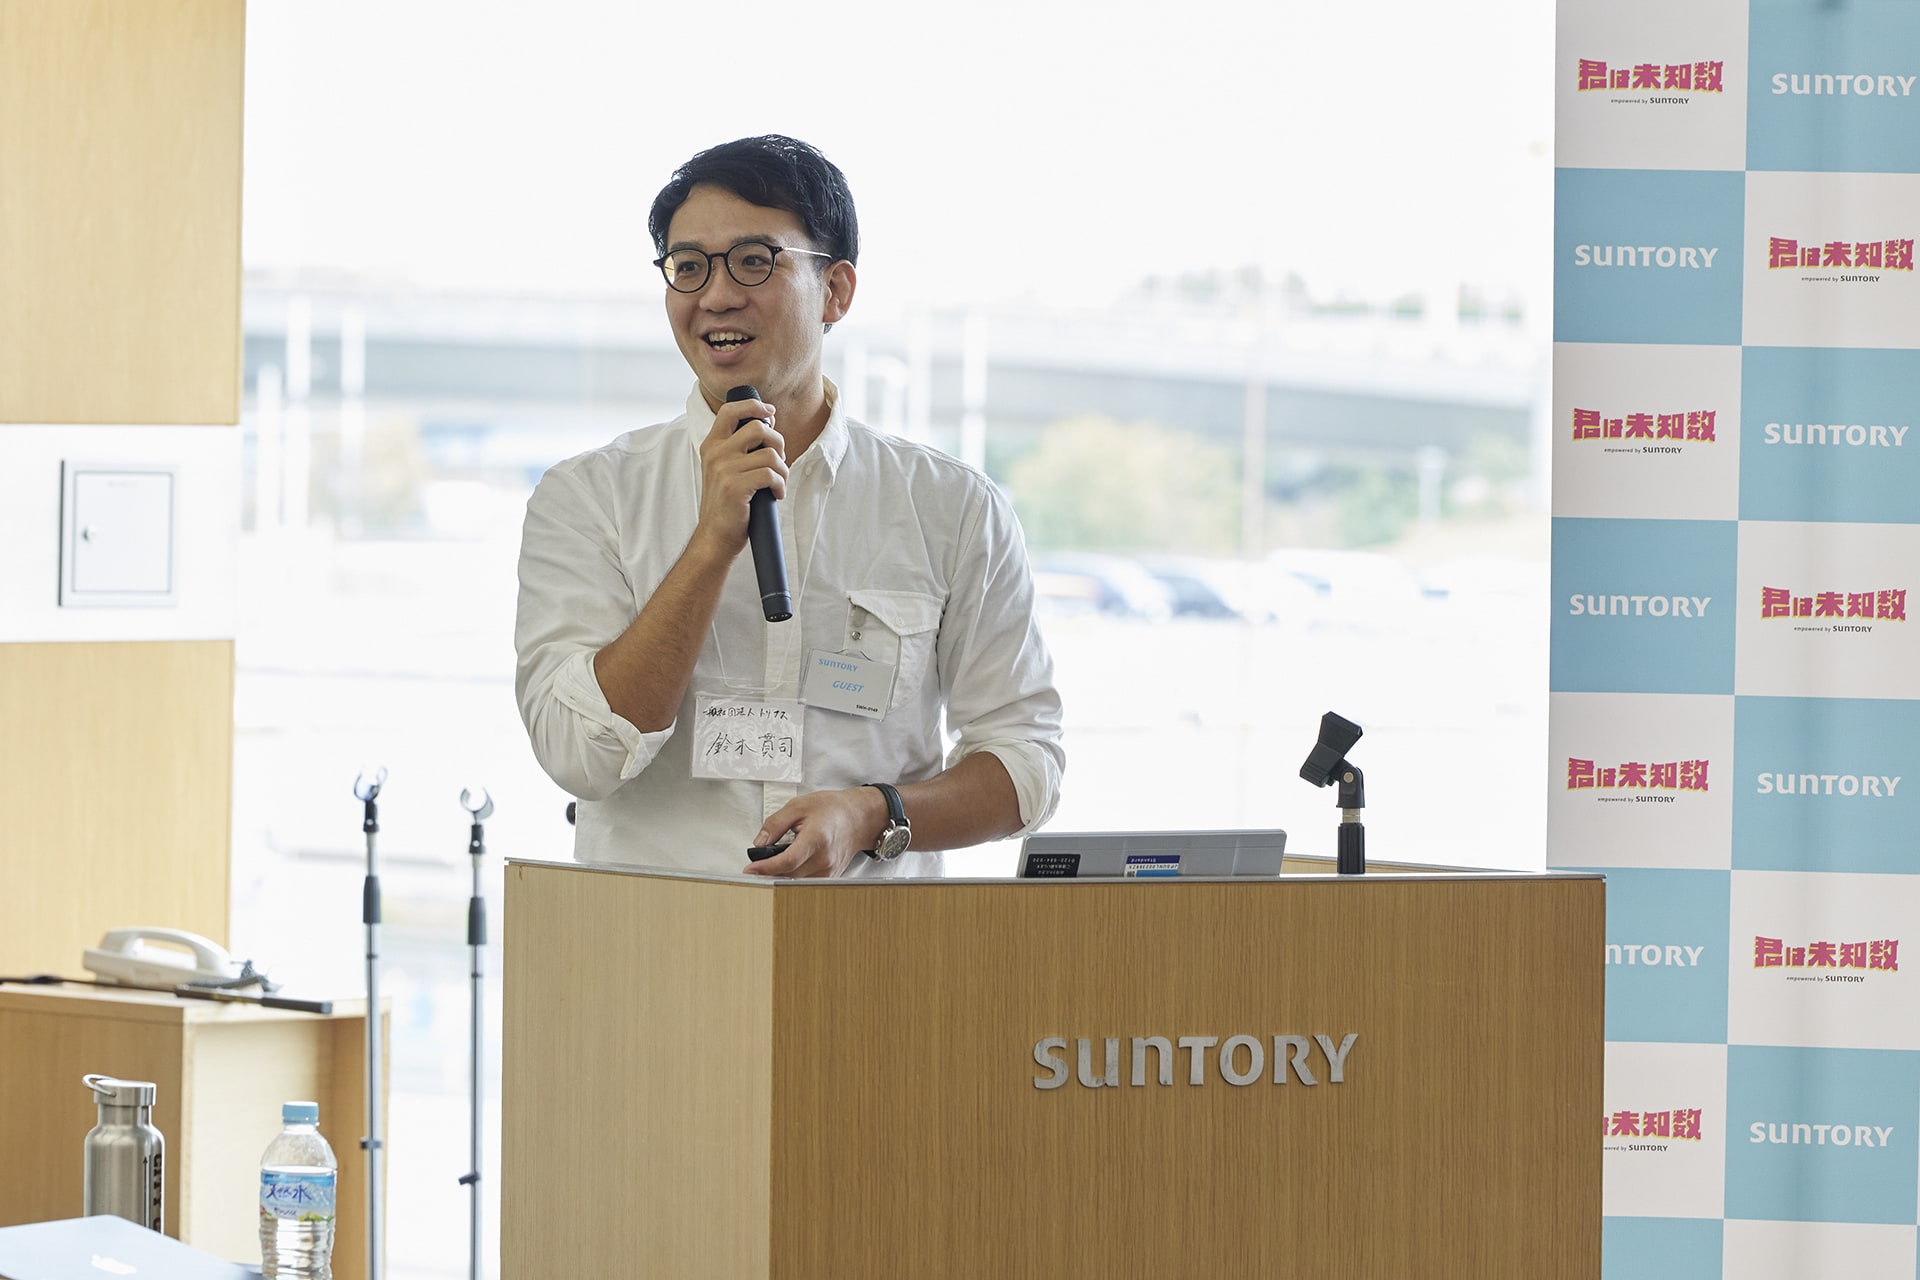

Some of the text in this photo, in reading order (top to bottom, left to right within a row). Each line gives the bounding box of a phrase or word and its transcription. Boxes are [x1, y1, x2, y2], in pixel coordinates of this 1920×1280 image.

[1577, 58, 1724, 95] 君は未知数
[1771, 73, 1917, 97] SUNTORY
[1649, 96, 1690, 105] SUNTORY
[1575, 244, 1719, 269] SUNTORY
[1767, 236, 1915, 273] 君は未知数
[1840, 274, 1881, 283] SUNTORY
[1571, 408, 1716, 445] 君は未知数
[1764, 423, 1910, 448] SUNTORY
[1642, 446, 1683, 455] SUNTORY
[1570, 594, 1713, 618] SUNTORY
[1760, 586, 1907, 624] 君は未知数
[1832, 624, 1873, 633] SUNTORY
[818, 658, 858, 672] SUNTORY
[832, 680, 864, 693] GUEST
[1566, 757, 1710, 794] 君は未知数
[1756, 773, 1902, 797] SUNTORY
[1635, 795, 1676, 804] SUNTORY
[1606, 944, 1705, 968] NTORY
[1752, 936, 1900, 975] 君は未知数
[1825, 974, 1866, 983] SUNTORY
[1033, 1033, 1359, 1089] SUNTORY
[1603, 1107, 1702, 1141] 未知数
[1750, 1122, 1894, 1147] SUNTORY
[1628, 1144, 1668, 1152] SUNTORY
